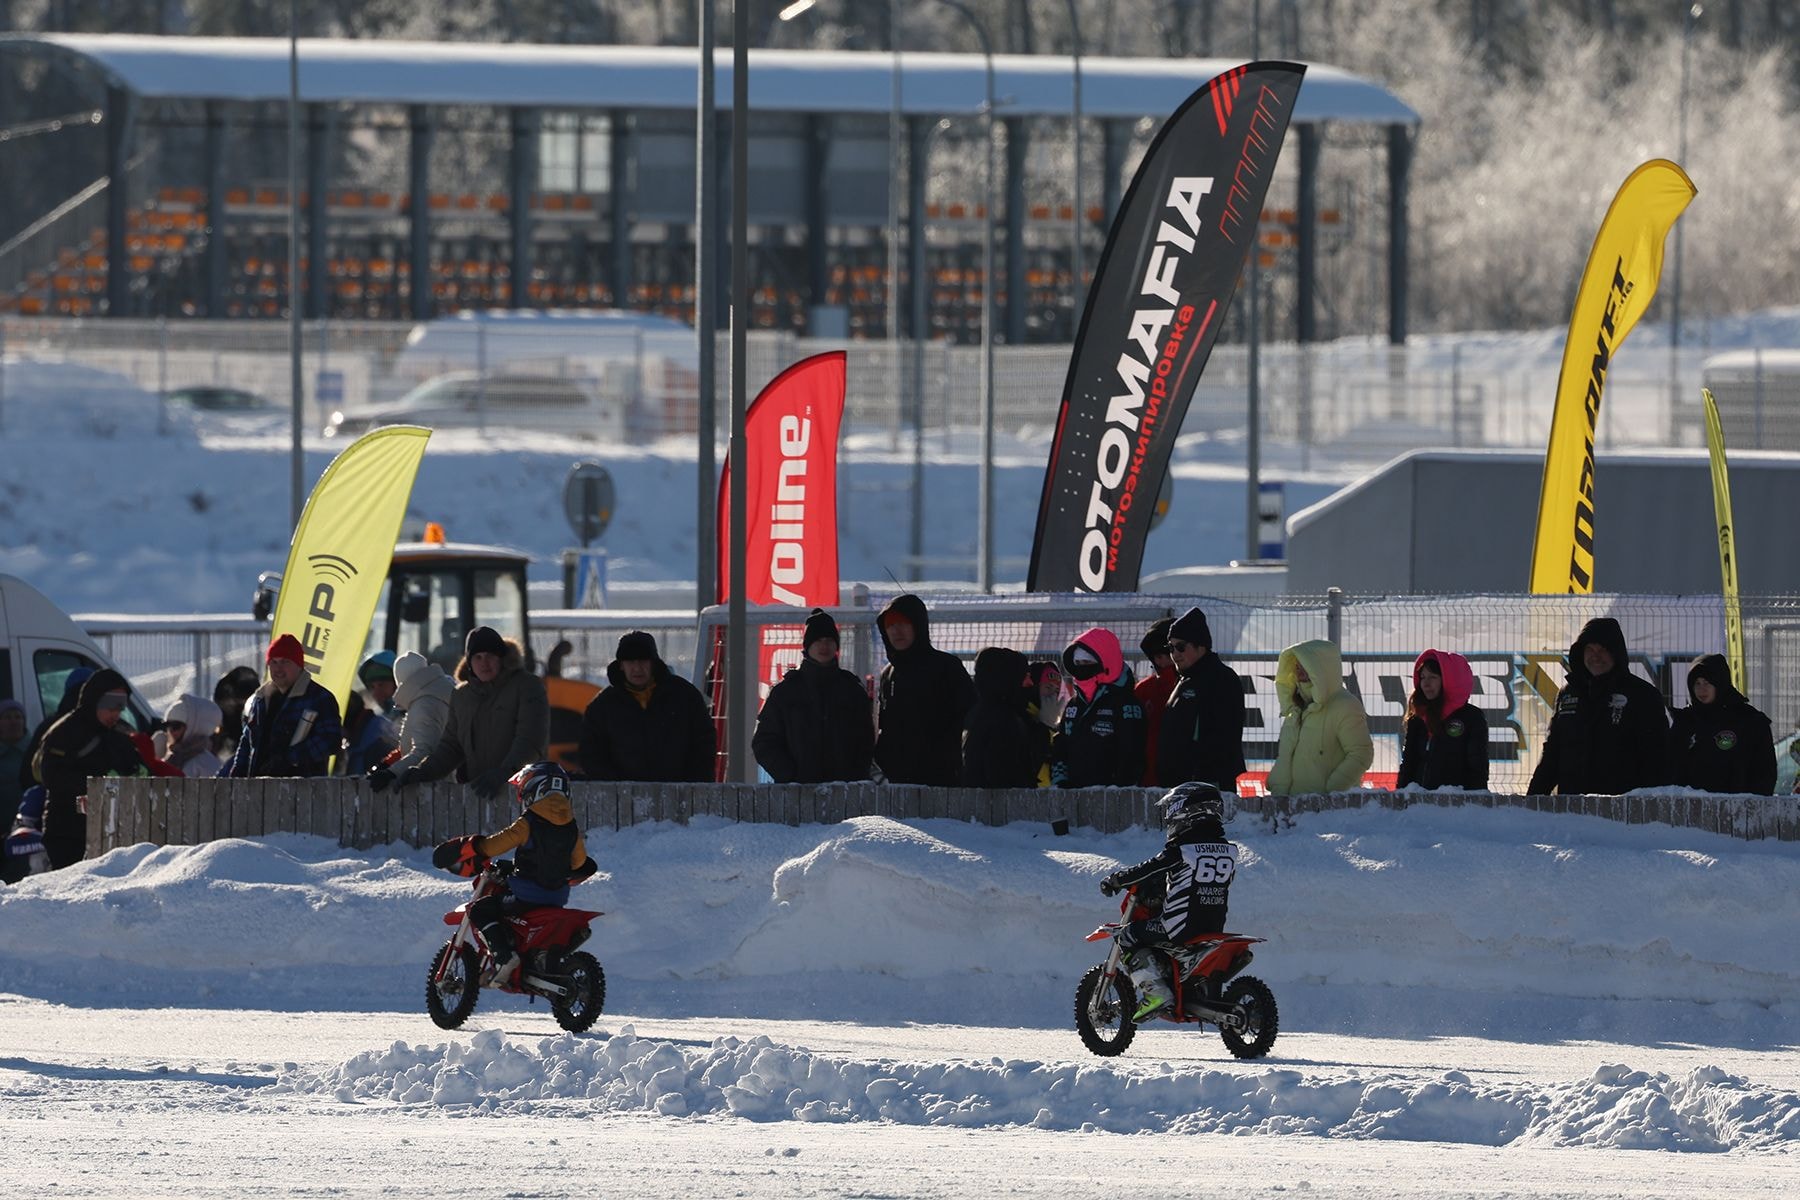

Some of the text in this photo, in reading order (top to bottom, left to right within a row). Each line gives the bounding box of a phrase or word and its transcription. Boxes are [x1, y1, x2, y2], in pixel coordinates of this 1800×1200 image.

[1073, 176, 1215, 592] OTOMAFIA
[1194, 843, 1230, 854] USHAKOV
[1194, 857, 1233, 884] 69
